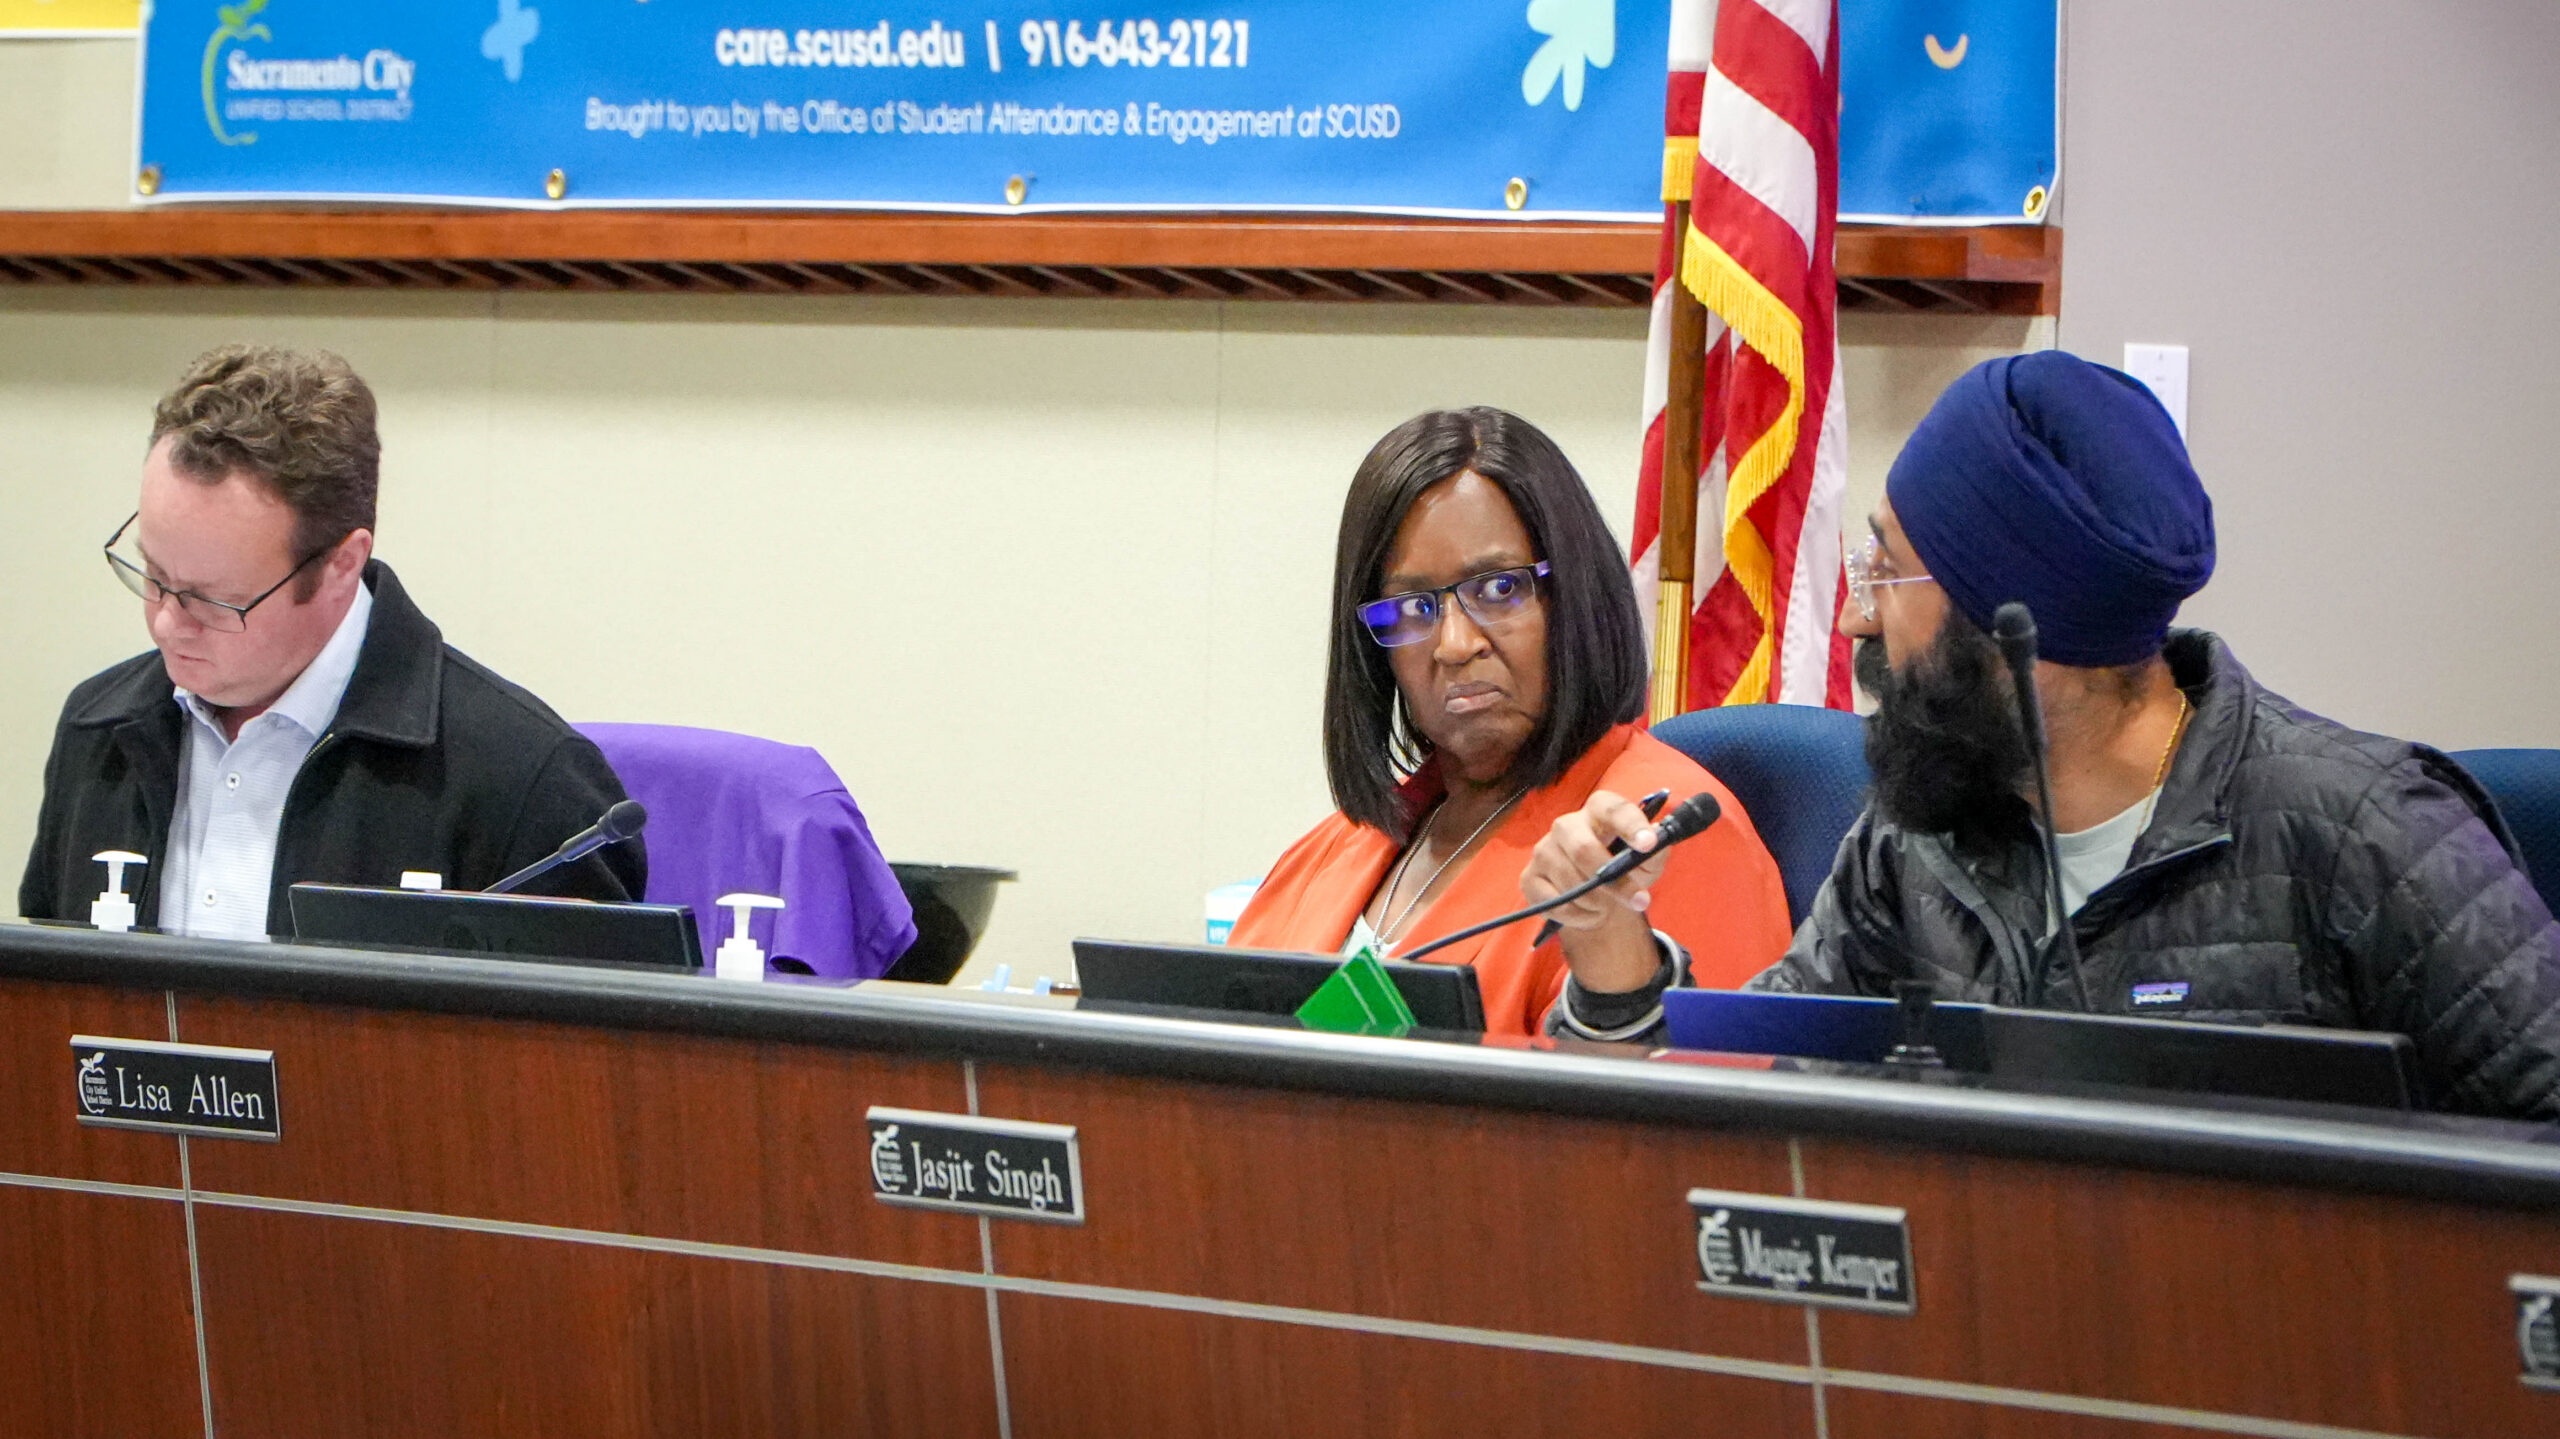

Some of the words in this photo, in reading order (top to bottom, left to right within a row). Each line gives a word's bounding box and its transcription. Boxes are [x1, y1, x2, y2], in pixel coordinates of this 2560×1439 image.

[715, 20, 965, 67] care.scusd.edu
[1019, 19, 1248, 68] 916-643-2121
[226, 49, 361, 91] Sacramento
[363, 49, 416, 99] City
[585, 97, 664, 138] Brought
[666, 99, 690, 132] to
[690, 104, 730, 138] you
[731, 99, 760, 138] by
[763, 99, 800, 133] the
[802, 99, 868, 134] Office
[870, 100, 895, 134] of
[898, 99, 983, 135] Student
[986, 101, 1120, 136] Attendance
[1123, 101, 1142, 136] &
[1146, 101, 1295, 145] Engagement
[1296, 103, 1323, 138] at
[1325, 103, 1400, 138] SCUSD
[115, 1066, 173, 1112] Lisa
[187, 1073, 265, 1120] Allen
[911, 1140, 976, 1201] Jasjit
[985, 1150, 1064, 1211] Singh
